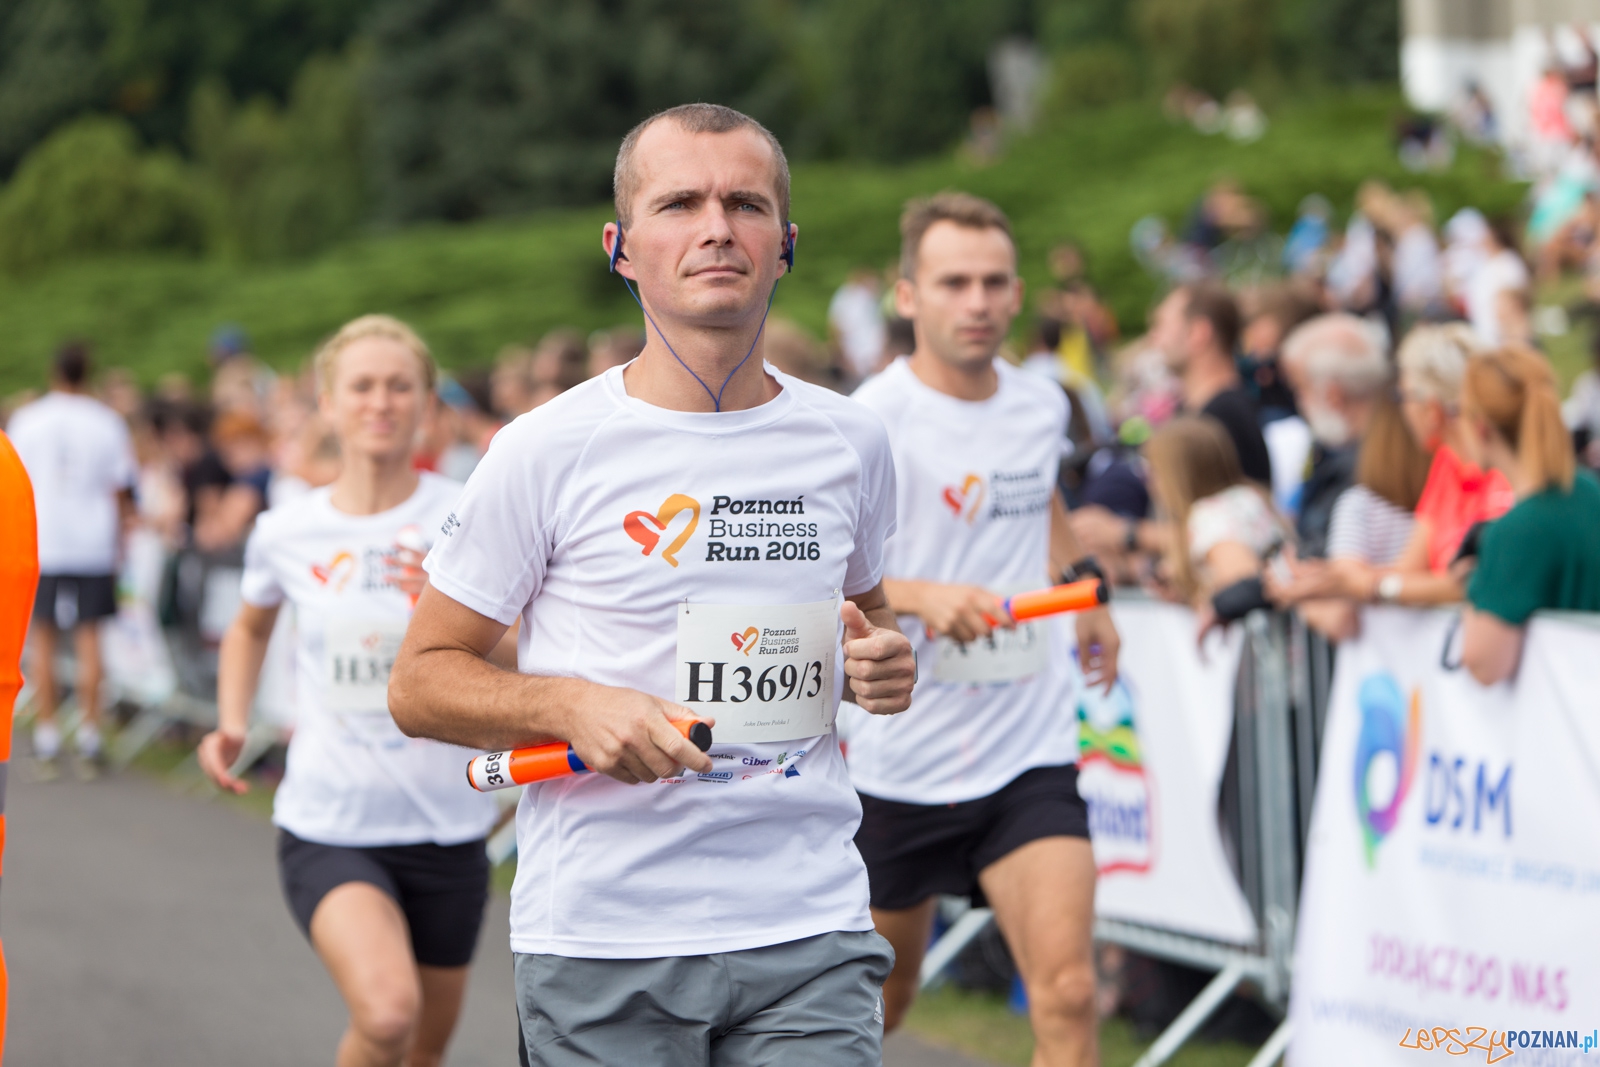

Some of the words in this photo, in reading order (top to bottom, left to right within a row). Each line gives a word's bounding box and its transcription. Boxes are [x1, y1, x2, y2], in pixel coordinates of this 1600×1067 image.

[711, 495, 804, 515] Poznań
[708, 518, 818, 538] Business
[705, 542, 760, 561] Run
[766, 541, 820, 561] 2016
[760, 637, 800, 646] Business
[762, 627, 797, 637] Poznań
[758, 646, 778, 655] Run
[779, 645, 799, 654] 2016
[683, 660, 822, 703] H369/3
[485, 752, 504, 786] 369
[1425, 752, 1513, 837] DSM
